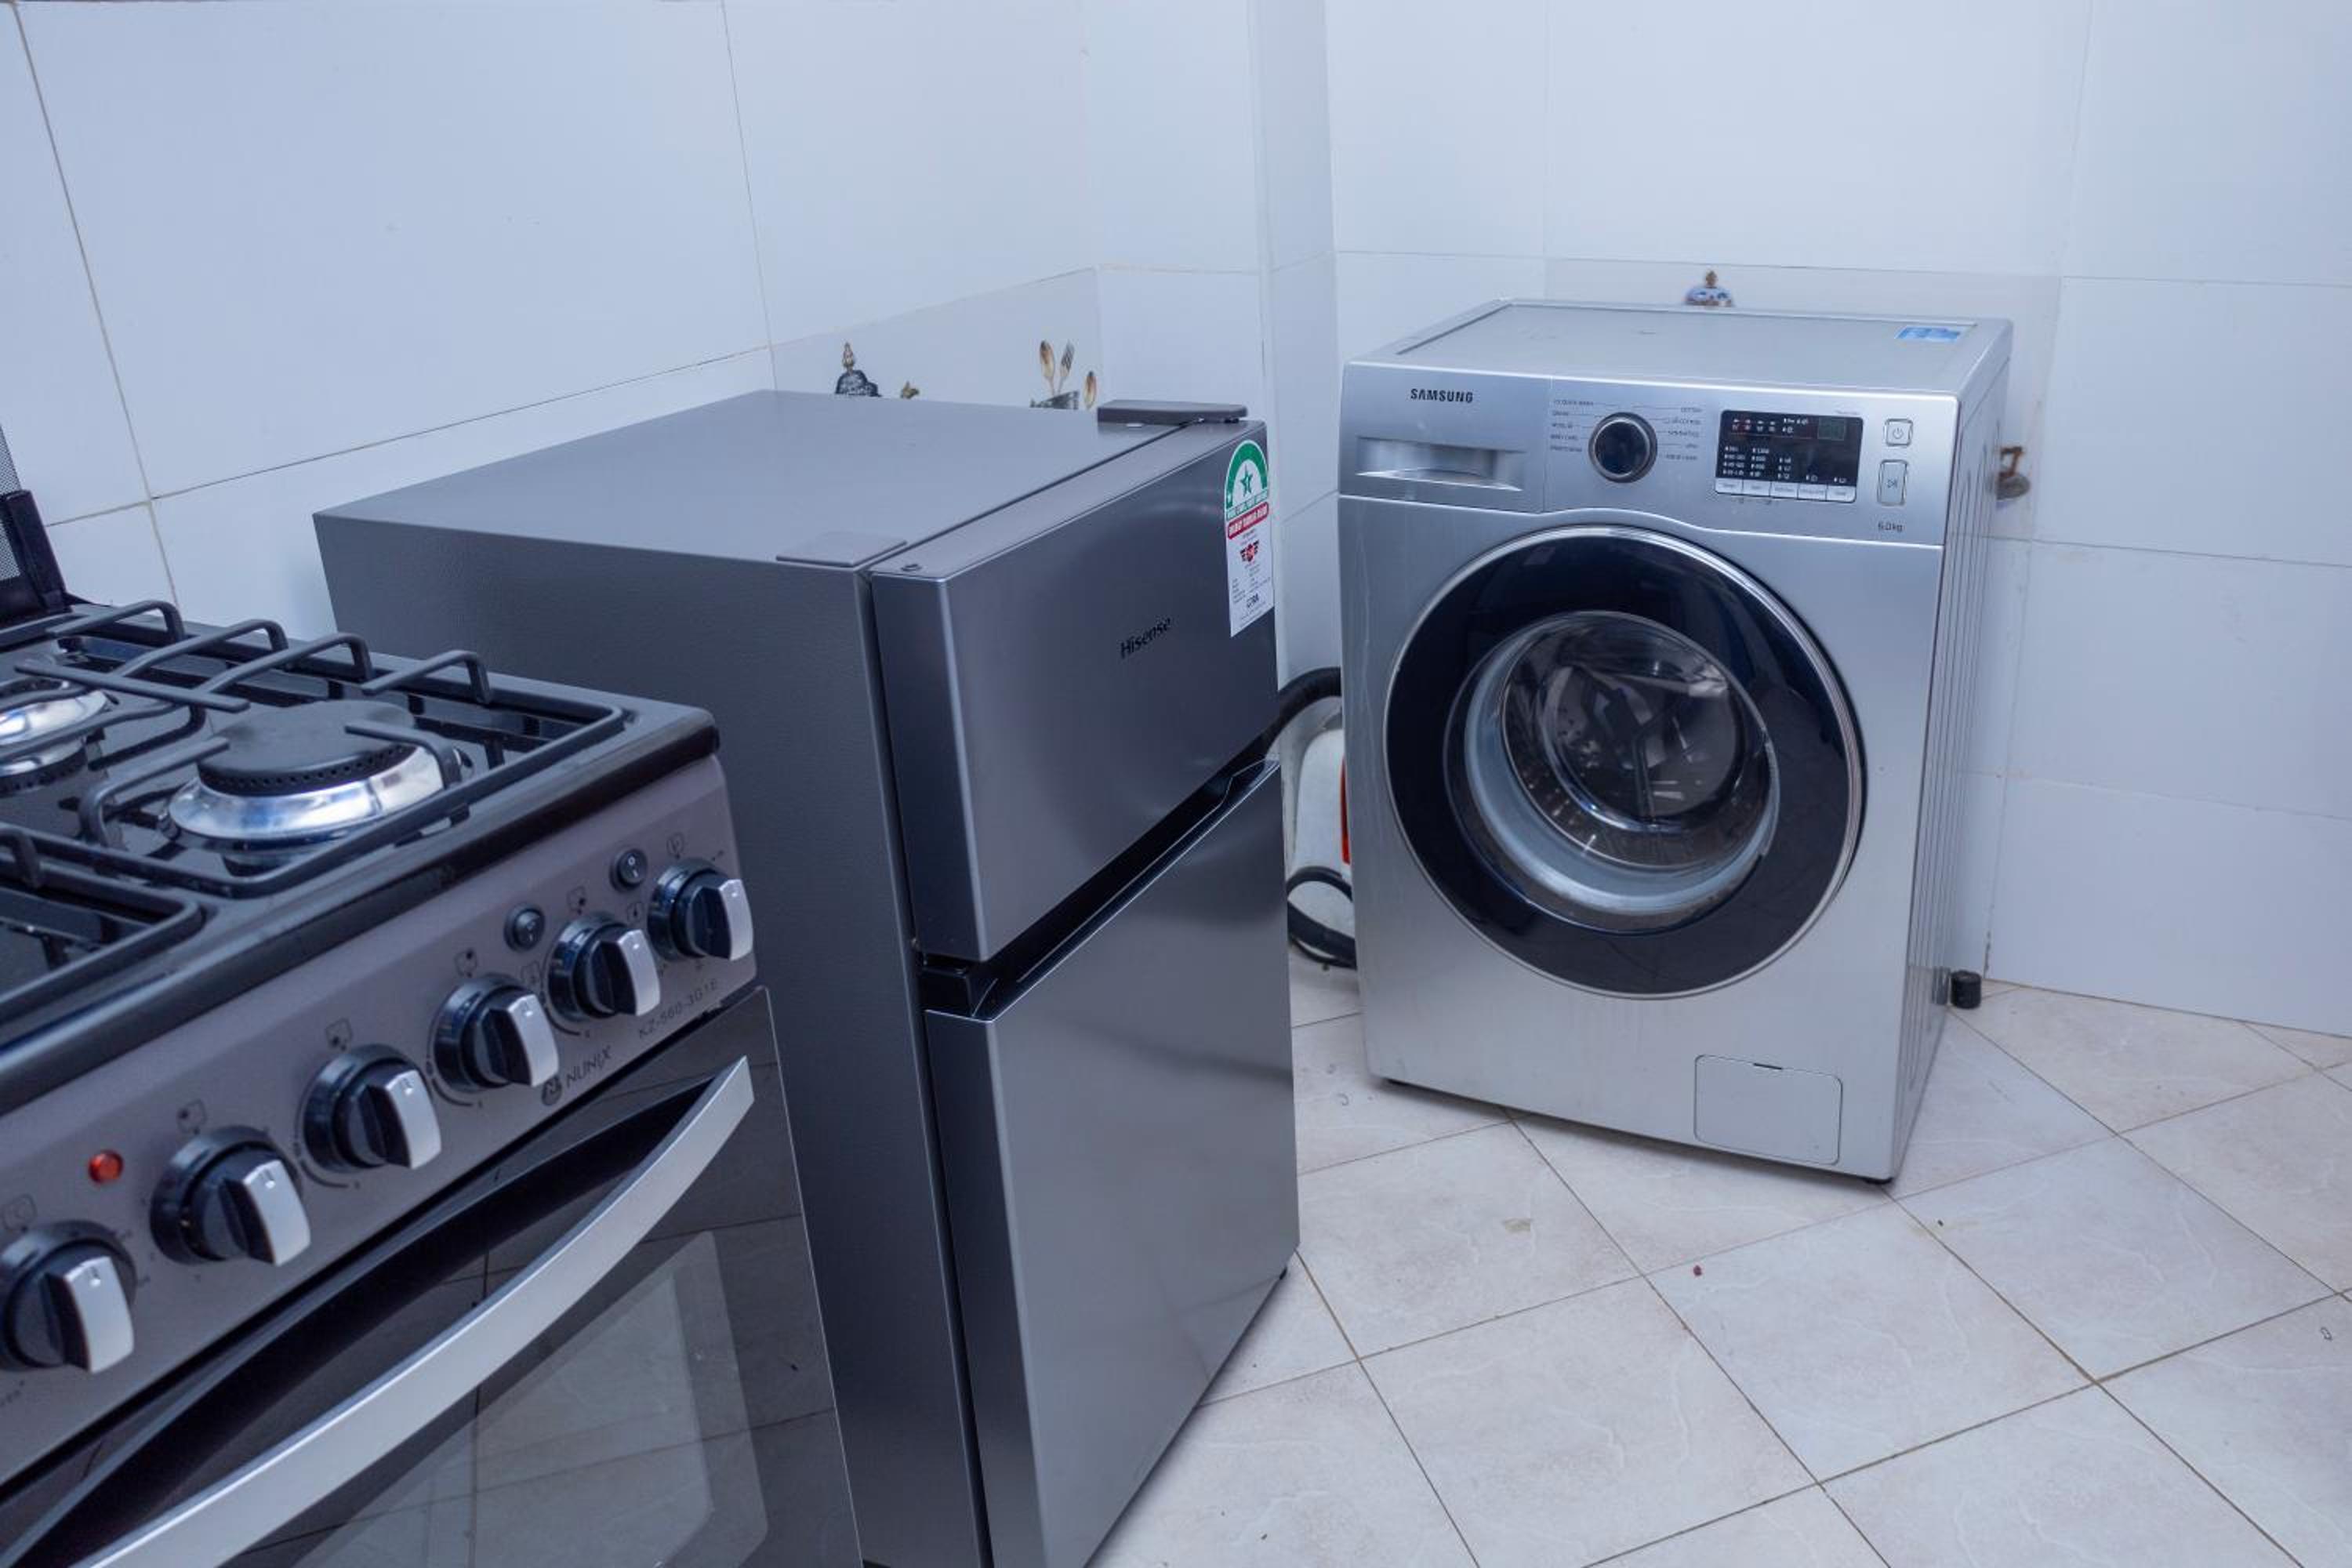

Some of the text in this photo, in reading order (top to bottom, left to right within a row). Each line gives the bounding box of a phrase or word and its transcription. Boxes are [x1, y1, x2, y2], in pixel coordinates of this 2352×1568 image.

[1410, 388, 1474, 404] SAMSUNG
[1120, 617, 1171, 659] Hisense
[564, 1044, 612, 1089] NUNIX
